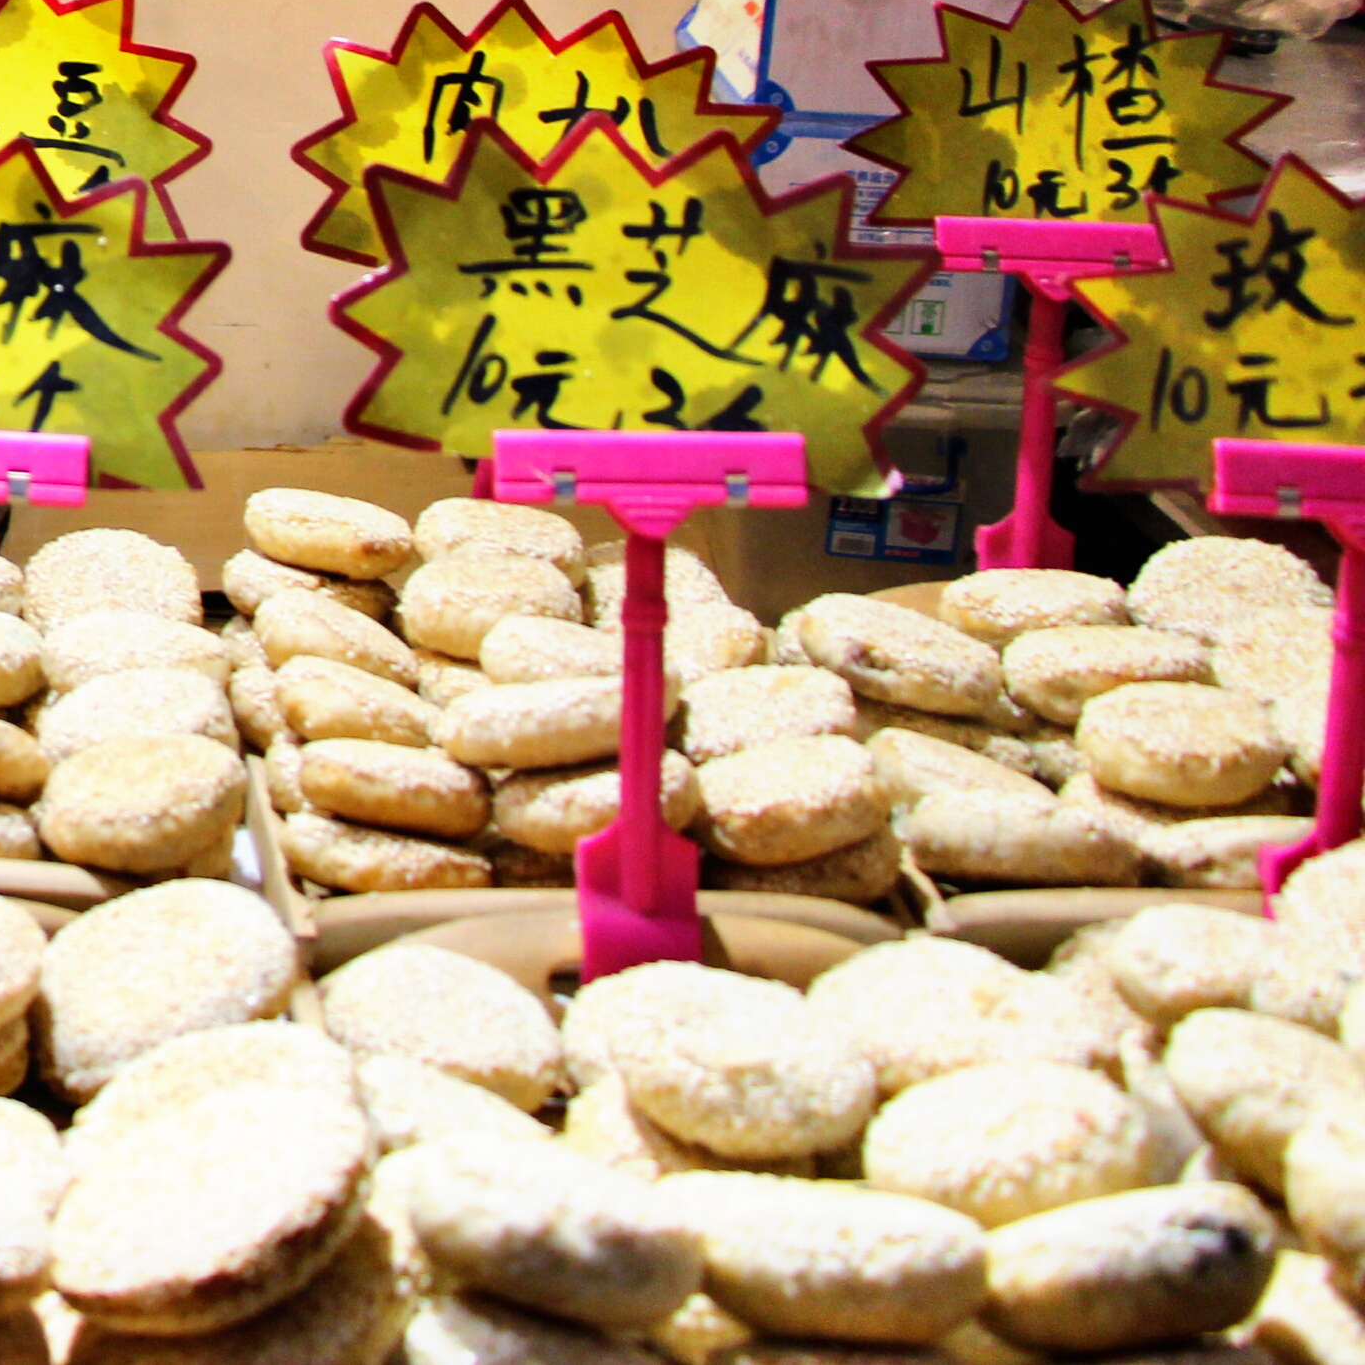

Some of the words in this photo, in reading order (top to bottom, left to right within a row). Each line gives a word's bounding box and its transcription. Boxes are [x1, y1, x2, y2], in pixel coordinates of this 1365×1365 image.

[960, 24, 1176, 168] 山楂
[459, 189, 888, 396] 黑芝麻
[1150, 348, 1365, 430] 10元
